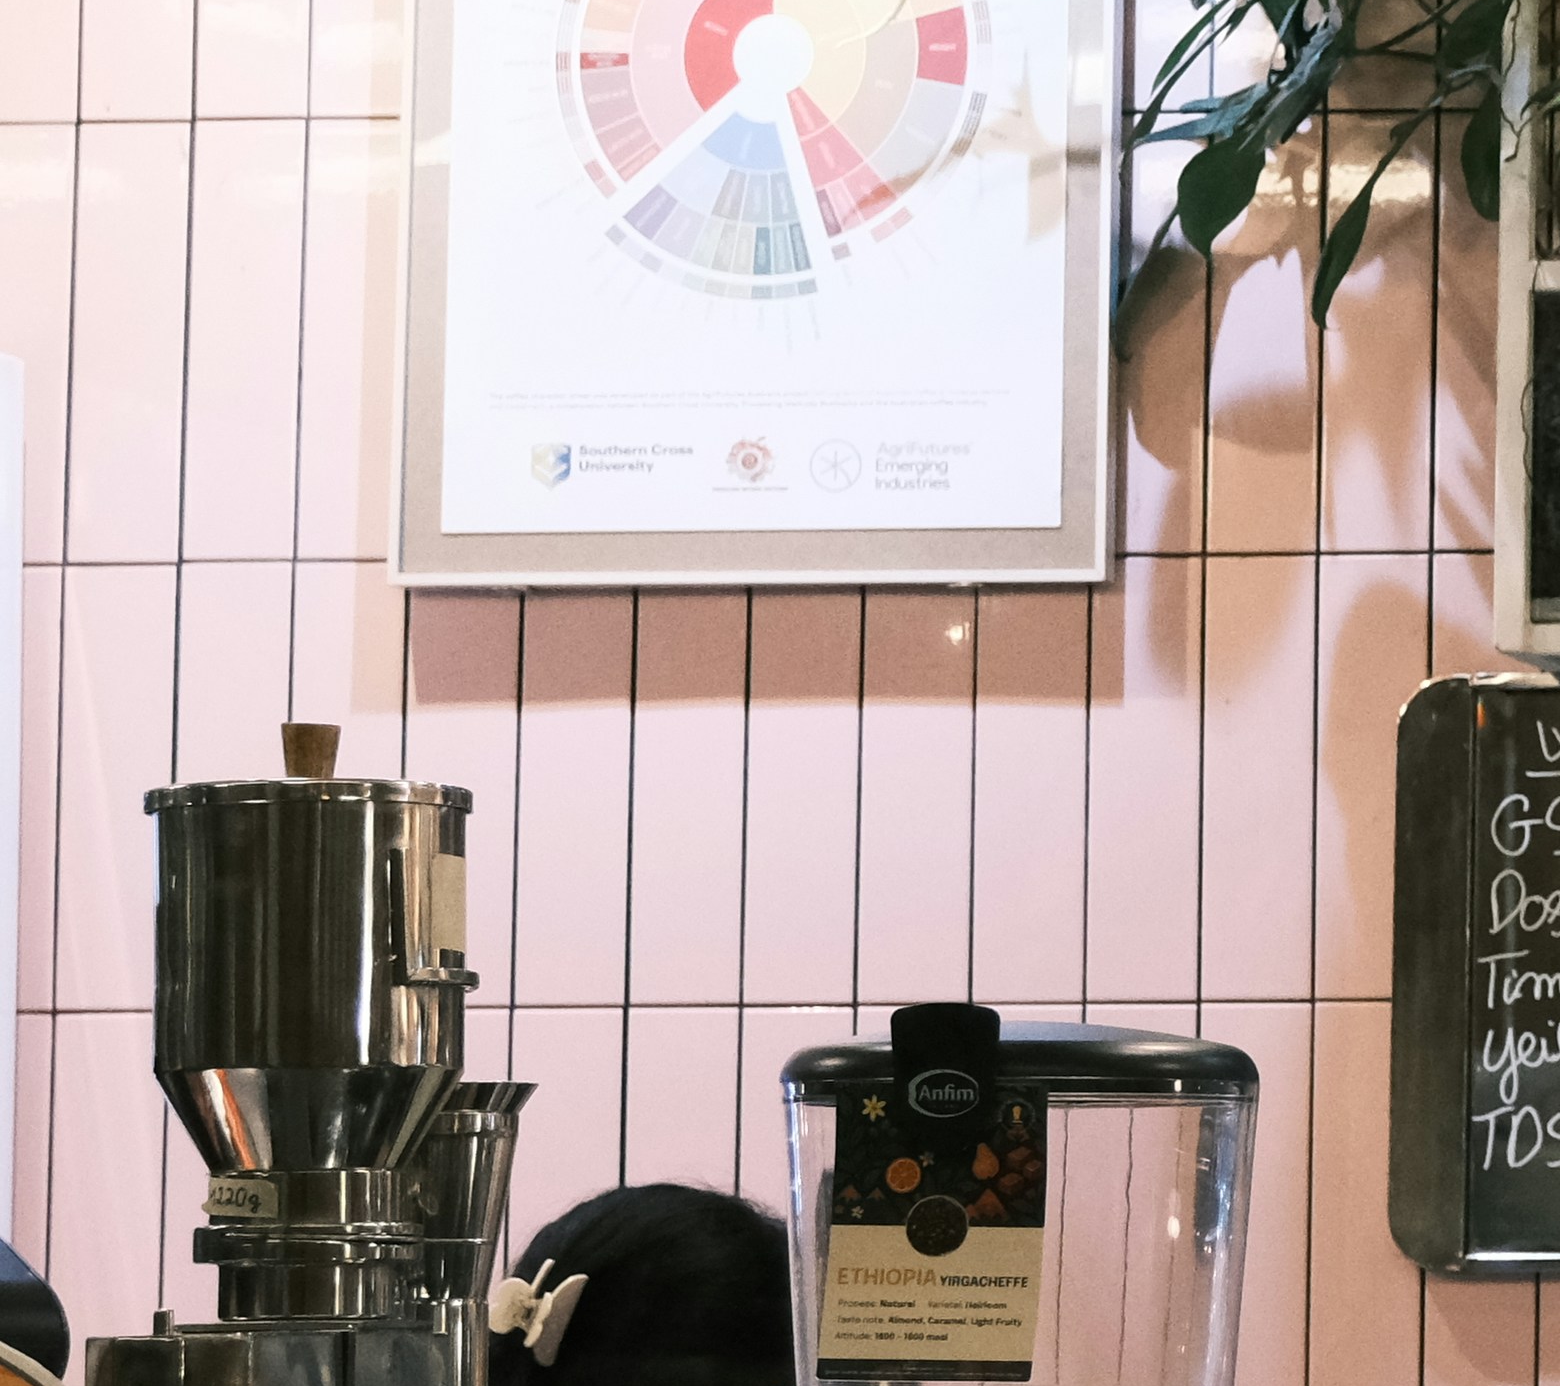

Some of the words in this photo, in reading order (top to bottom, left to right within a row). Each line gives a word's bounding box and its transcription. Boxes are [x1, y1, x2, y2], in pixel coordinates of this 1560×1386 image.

[579, 444, 648, 457] Southern
[652, 444, 694, 456] Cross
[876, 441, 972, 457] AgriFutures
[579, 460, 655, 474] University
[874, 459, 949, 477] Emerging
[874, 475, 951, 491] Industries
[918, 1083, 975, 1102] Anfim
[836, 1266, 937, 1287] ETHIOPIA
[939, 1275, 1029, 1289] YIRGACHEFFE
[879, 1299, 916, 1309] Natural
[888, 1316, 926, 1326] Almond,
[927, 1317, 969, 1327] Caramel,
[970, 1318, 994, 1328] Light
[995, 1317, 1024, 1328] Fruity
